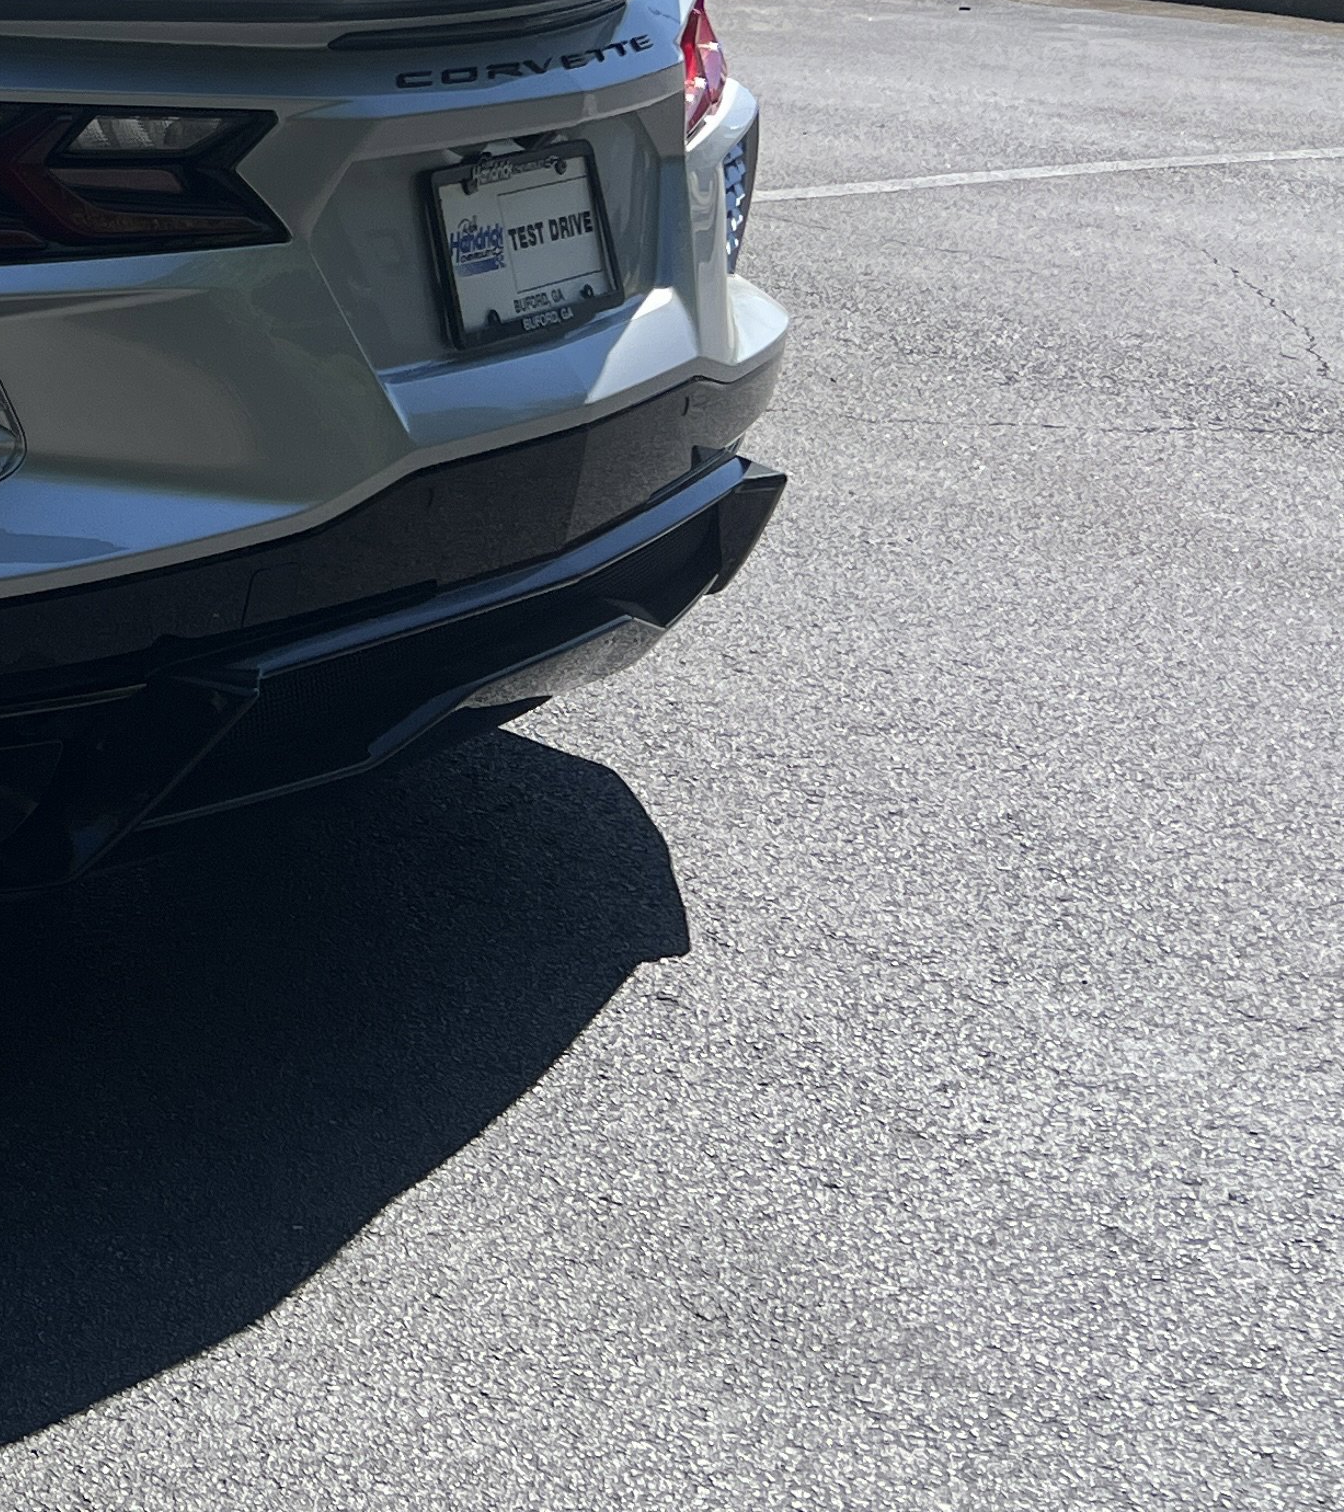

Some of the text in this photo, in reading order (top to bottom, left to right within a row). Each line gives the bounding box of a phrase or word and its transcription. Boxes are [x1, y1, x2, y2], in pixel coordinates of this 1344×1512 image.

[395, 34, 654, 88] CORVETTE
[508, 211, 593, 251] TEST DRIVE
[551, 288, 566, 303] GA
[560, 306, 574, 320] GA
